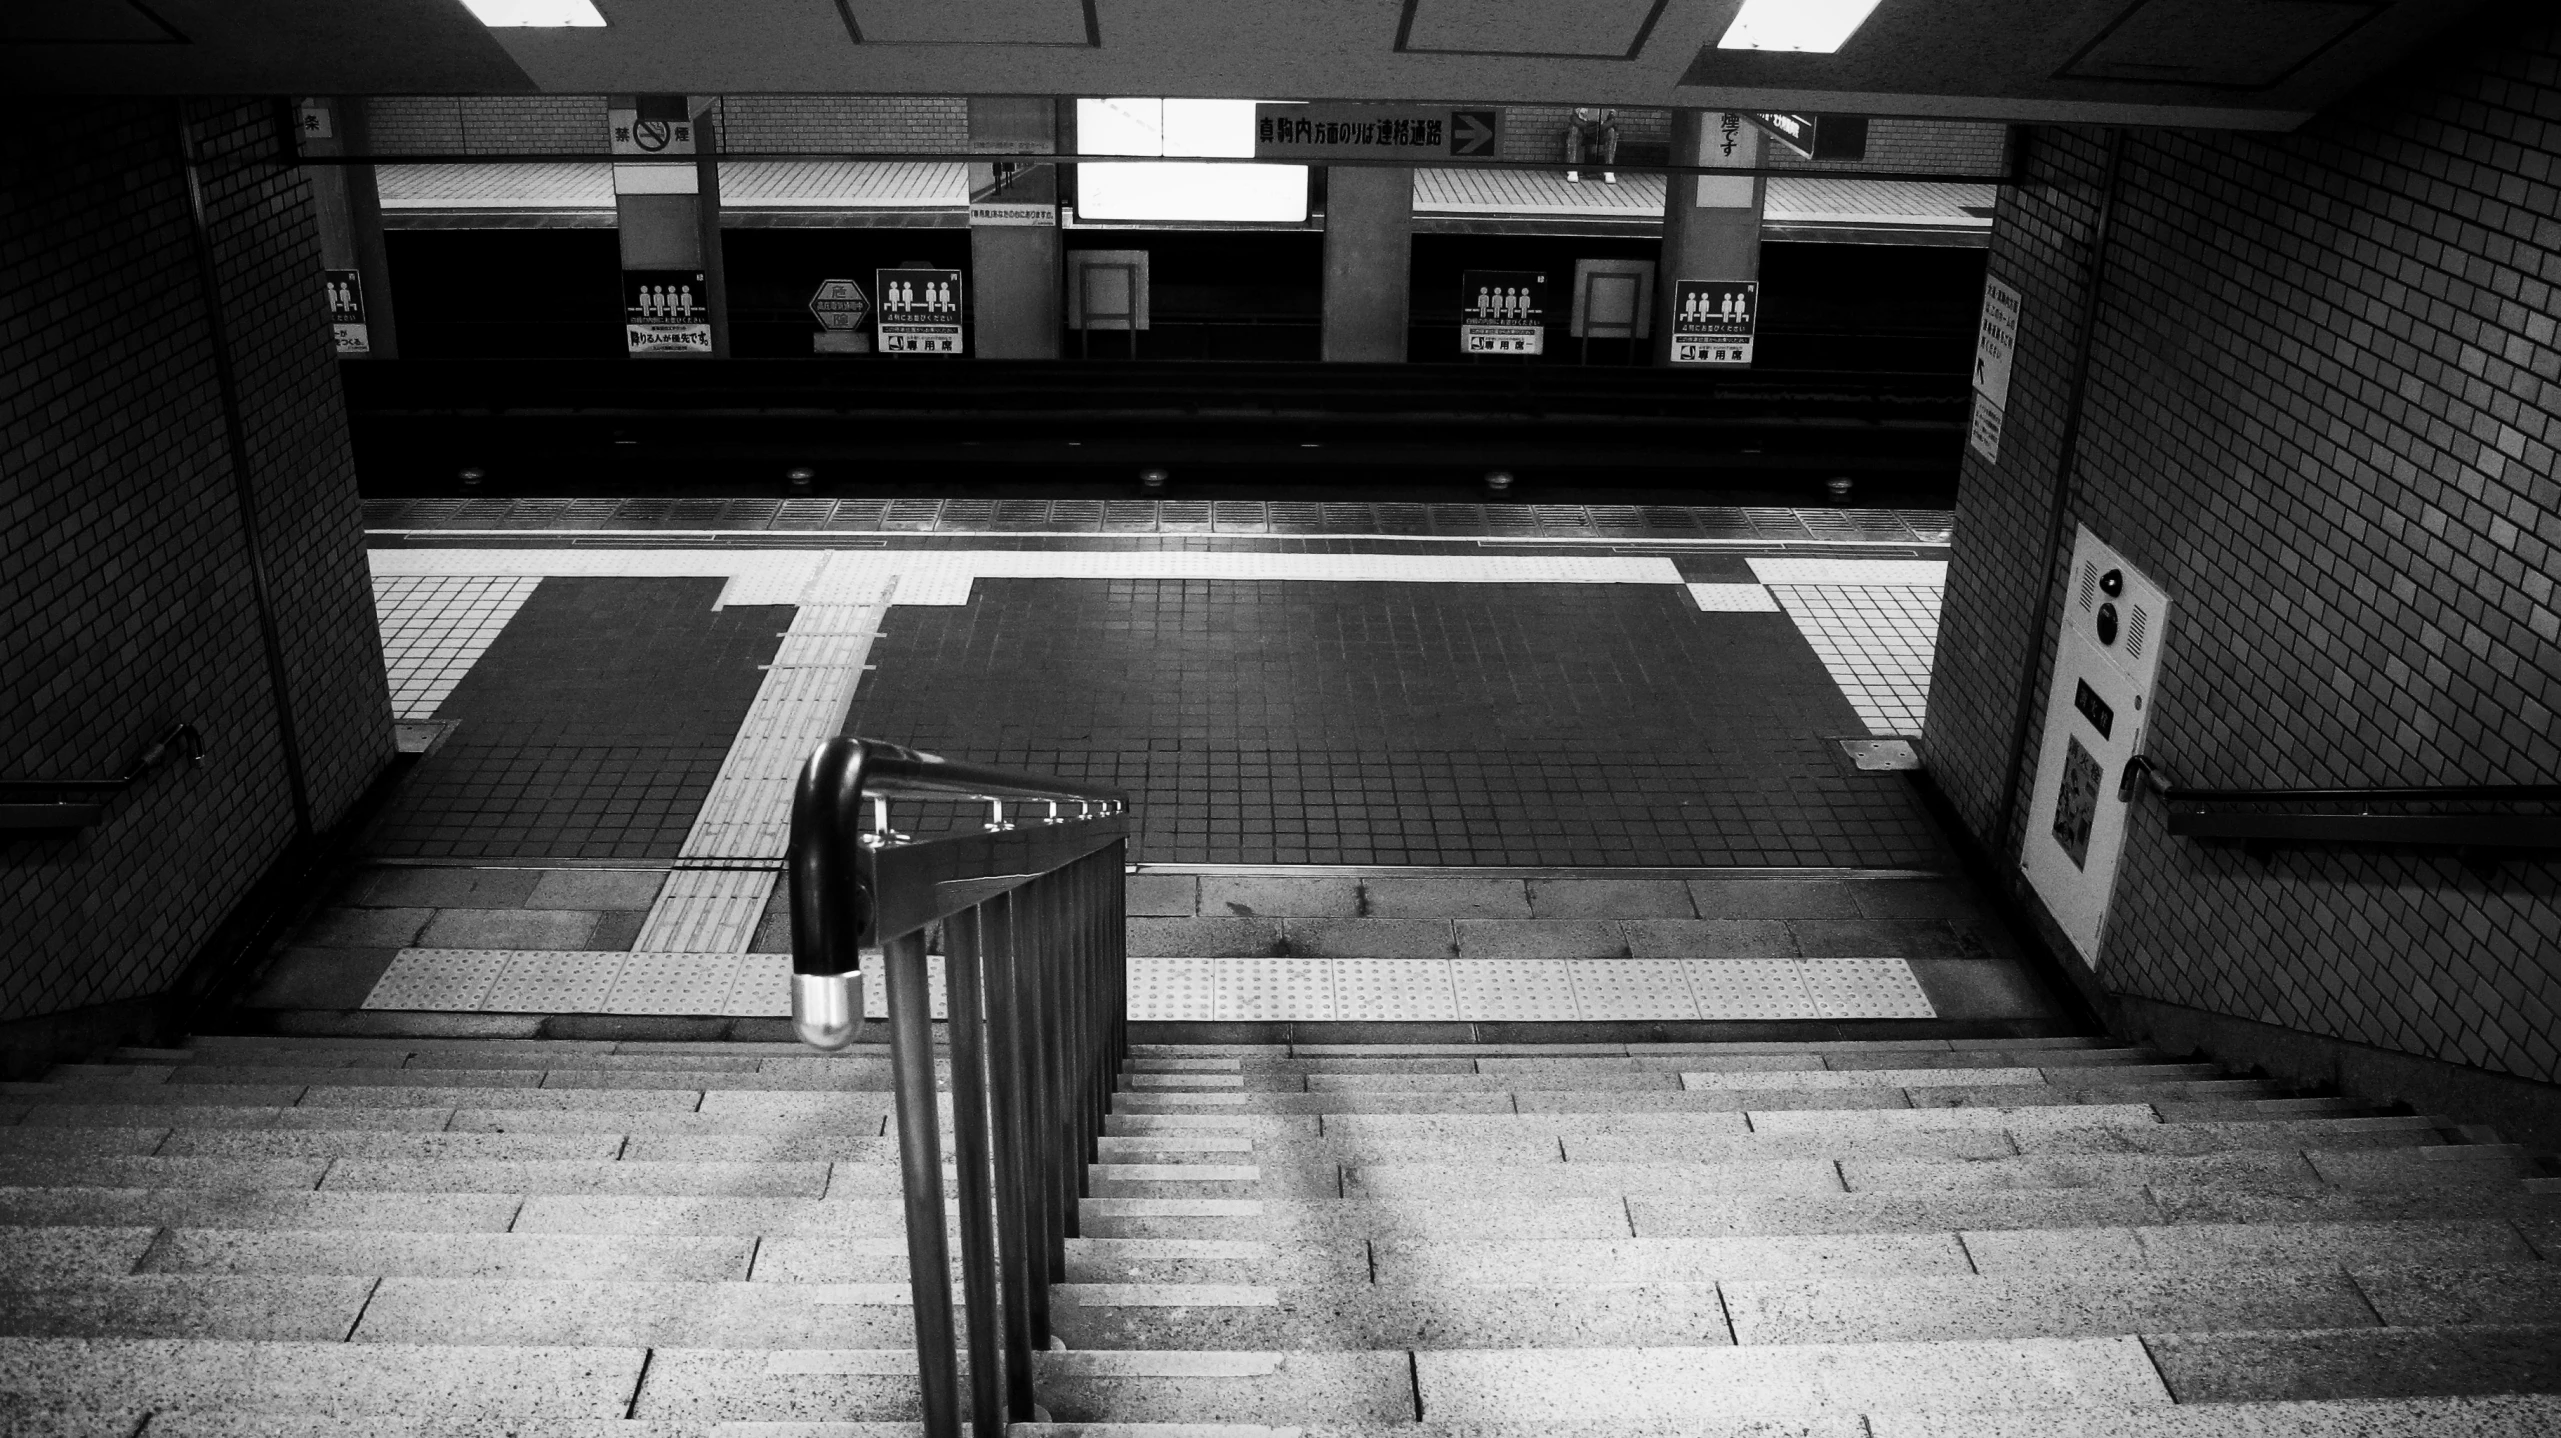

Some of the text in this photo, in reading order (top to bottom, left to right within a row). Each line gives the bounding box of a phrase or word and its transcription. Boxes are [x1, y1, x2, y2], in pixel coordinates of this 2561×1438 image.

[305, 115, 319, 130] 条
[615, 127, 689, 142] 禁 煙
[1260, 117, 1442, 146] 真駒内方面のりば連絡通路
[630, 331, 708, 346] 降りる人が優先です。
[2069, 740, 2101, 784] 消火栓
